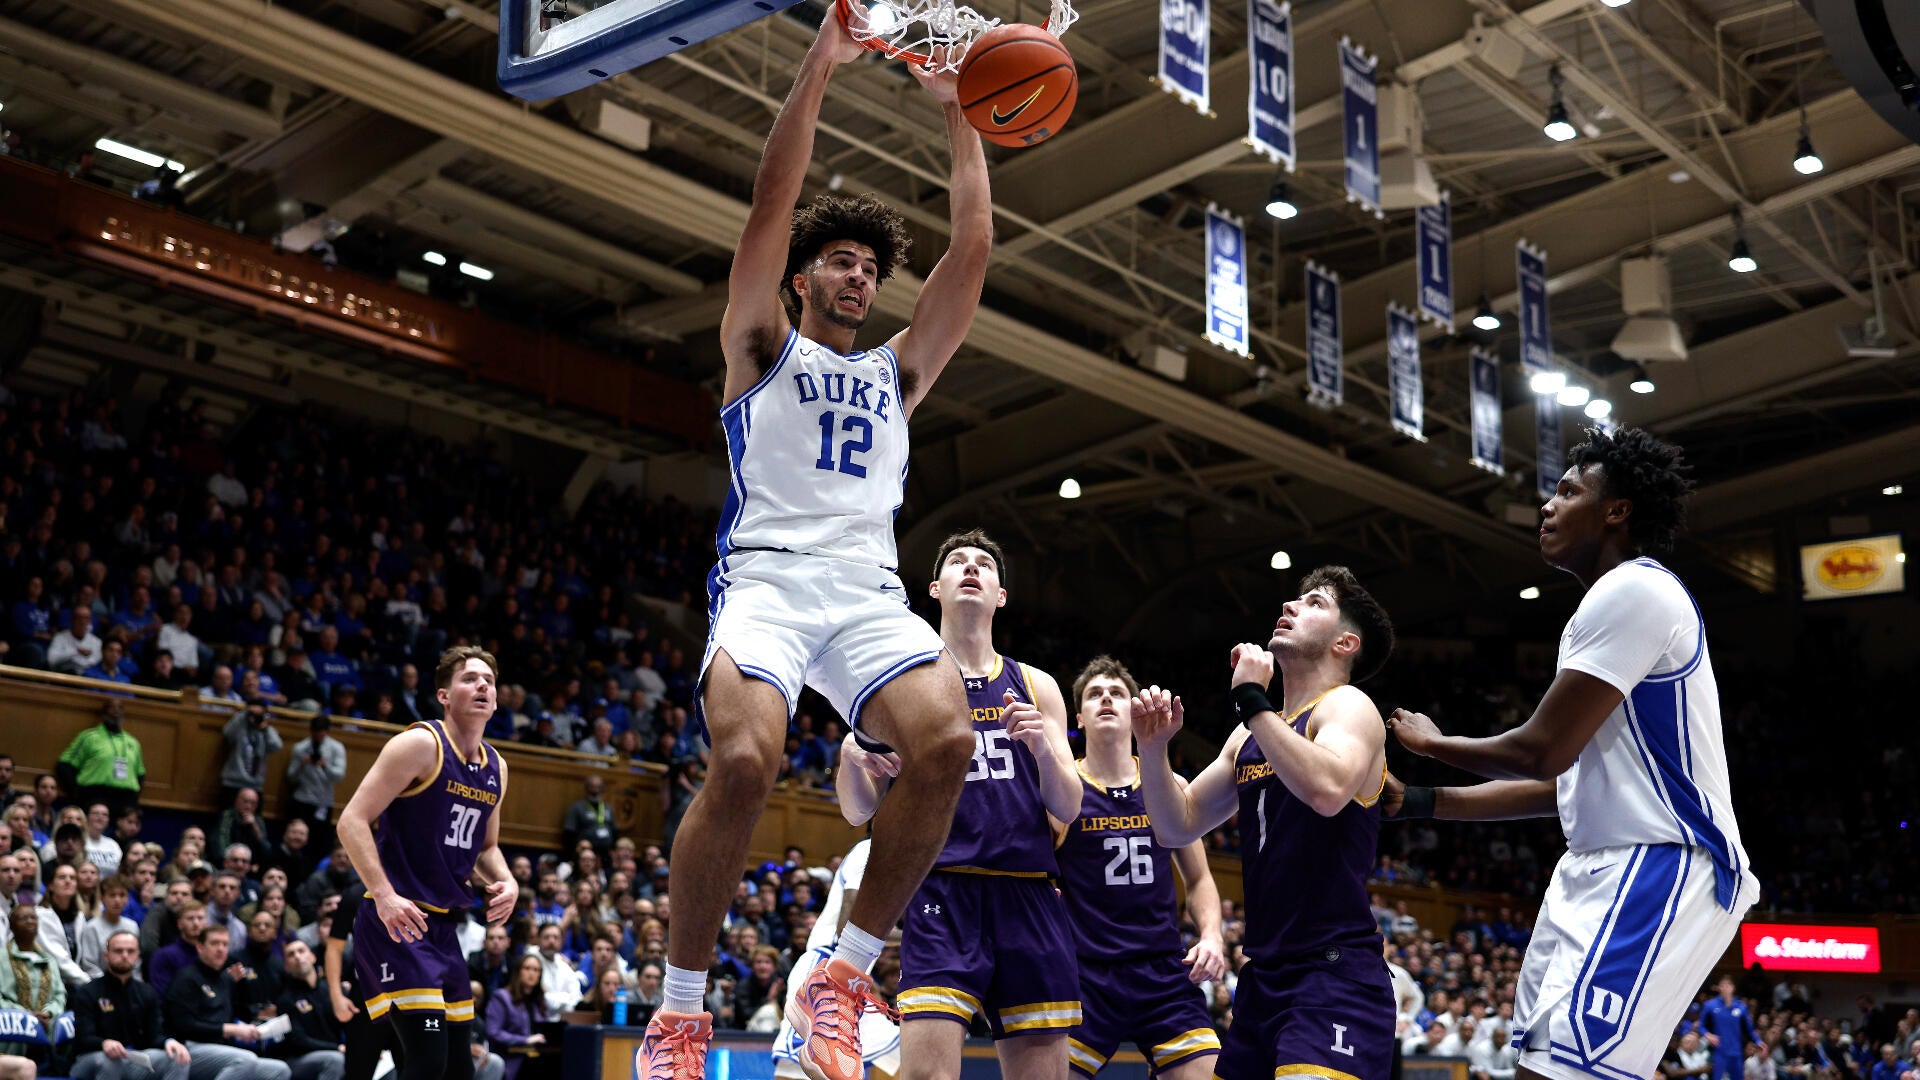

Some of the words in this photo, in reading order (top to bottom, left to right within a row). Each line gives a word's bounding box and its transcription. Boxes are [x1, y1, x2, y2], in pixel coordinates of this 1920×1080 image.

[1258, 60, 1287, 104] 10
[1356, 114, 1366, 149] 1
[1429, 243, 1442, 283] 1
[1530, 303, 1542, 339] 1
[793, 372, 891, 423] DUKE
[815, 410, 873, 479] 12
[446, 779, 498, 806] LIPSCOMB
[444, 803, 482, 850] 30
[1081, 814, 1151, 832] LIPSCOM
[1256, 788, 1267, 854] 1
[1103, 836, 1155, 886] 26
[380, 962, 395, 983] L
[0, 1011, 39, 1038] UKE
[1586, 985, 1624, 1025] D
[1330, 1023, 1355, 1057] L
